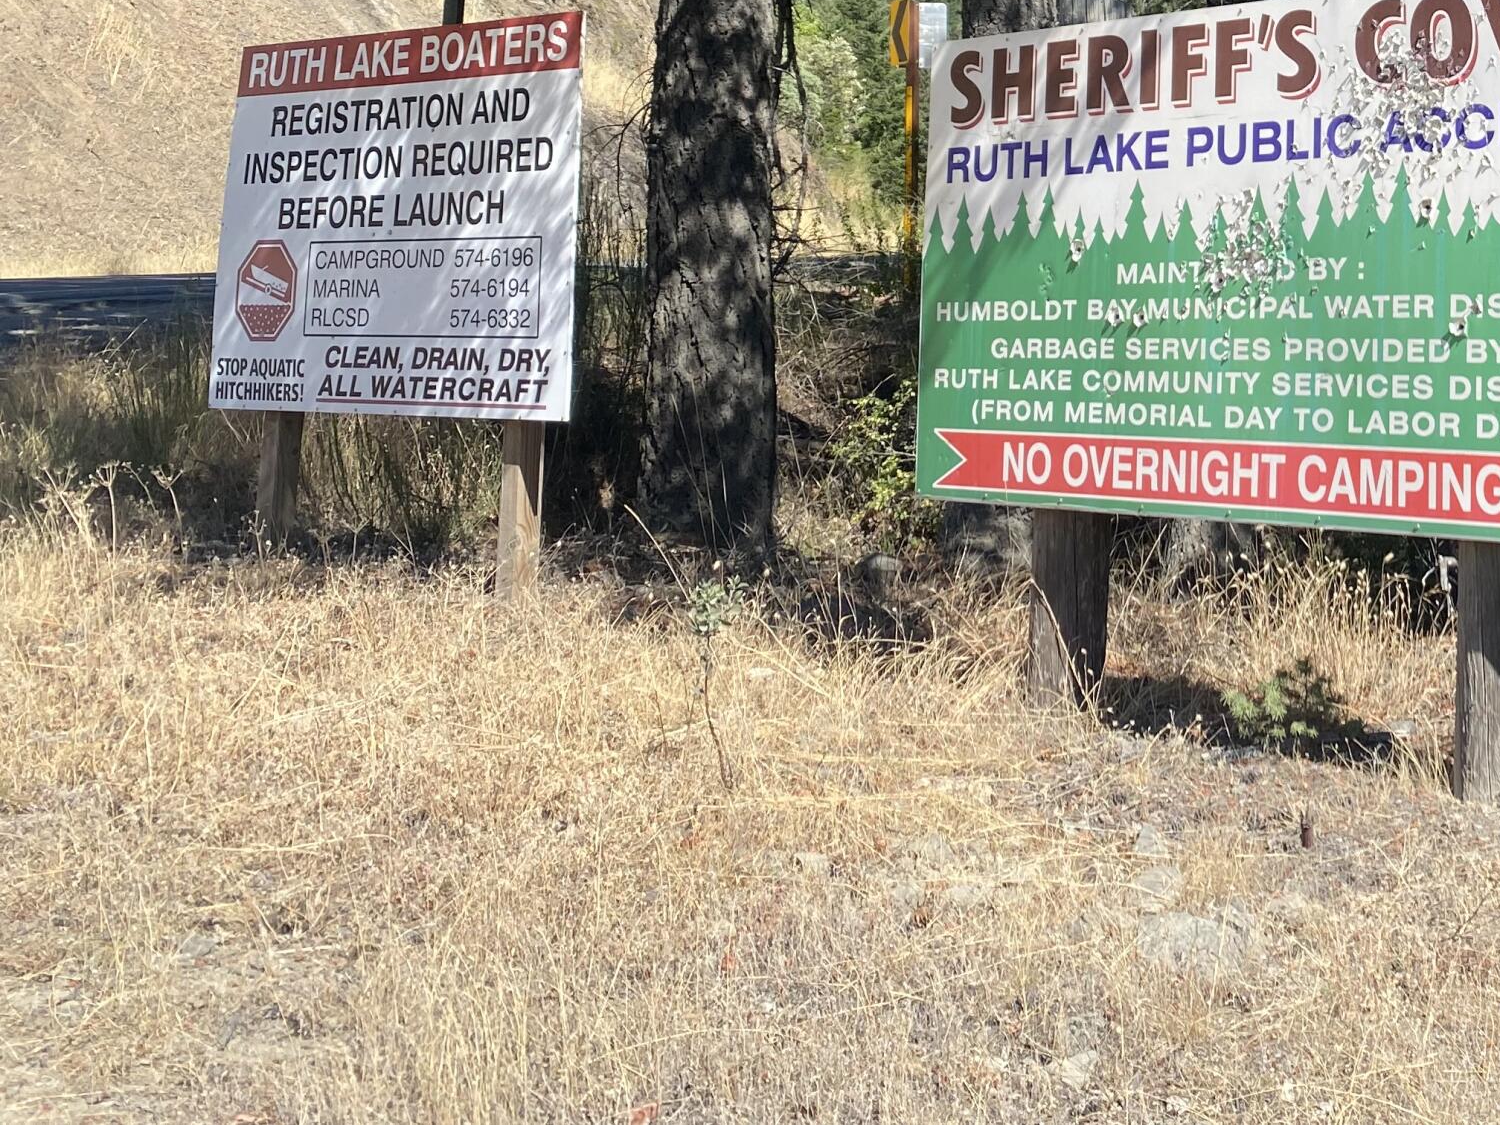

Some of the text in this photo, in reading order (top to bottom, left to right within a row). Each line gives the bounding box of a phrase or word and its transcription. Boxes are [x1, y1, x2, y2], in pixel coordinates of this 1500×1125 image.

[248, 21, 569, 88] RUTH LAKE BOATERS
[949, 8, 1320, 130] SHERIFF'S
[271, 88, 530, 137] REGISTRATION AND
[243, 137, 554, 185] INSPECTION REQUIRED
[946, 139, 1049, 184] RUTH
[1065, 130, 1169, 174] LAKE
[1186, 113, 1363, 167] PUBLIC
[278, 191, 505, 230] BEFORE LAUNCH
[315, 247, 534, 269] CAMPGROUND 574-6196
[1116, 256, 1296, 285] MAINTD
[1306, 258, 1349, 281] BY
[313, 279, 530, 298] MARINA 574-6194
[311, 308, 531, 329] RLCSD 574-6332
[935, 299, 1077, 322] HUMBOLDT
[1086, 301, 1139, 326] BAY
[1141, 297, 1314, 321] MUNICIPAL
[1324, 295, 1435, 320] WATER
[324, 346, 551, 377] CLEAN, DRAIN, DRY,
[990, 337, 1116, 360] GARBAGE
[1124, 337, 1271, 362] SERVICES
[1284, 338, 1451, 363] PROVIDED
[217, 358, 305, 380] STOP AQUATIC
[934, 367, 999, 388] RUTH
[1007, 368, 1072, 391] LAKE
[1082, 369, 1261, 394] COMMUNITY
[1272, 372, 1434, 401] SERVICES
[215, 381, 304, 402] HITCHHIKERS!
[317, 377, 549, 404] ALL WATERCRAFT
[971, 399, 1054, 423] (FROM
[1063, 401, 1213, 427] MEMORIAL
[1224, 405, 1284, 430] DAY
[1293, 407, 1334, 432] TO
[1347, 408, 1461, 438] LABOR
[1001, 442, 1052, 487] NO
[1061, 444, 1287, 499] OVERNIGHT
